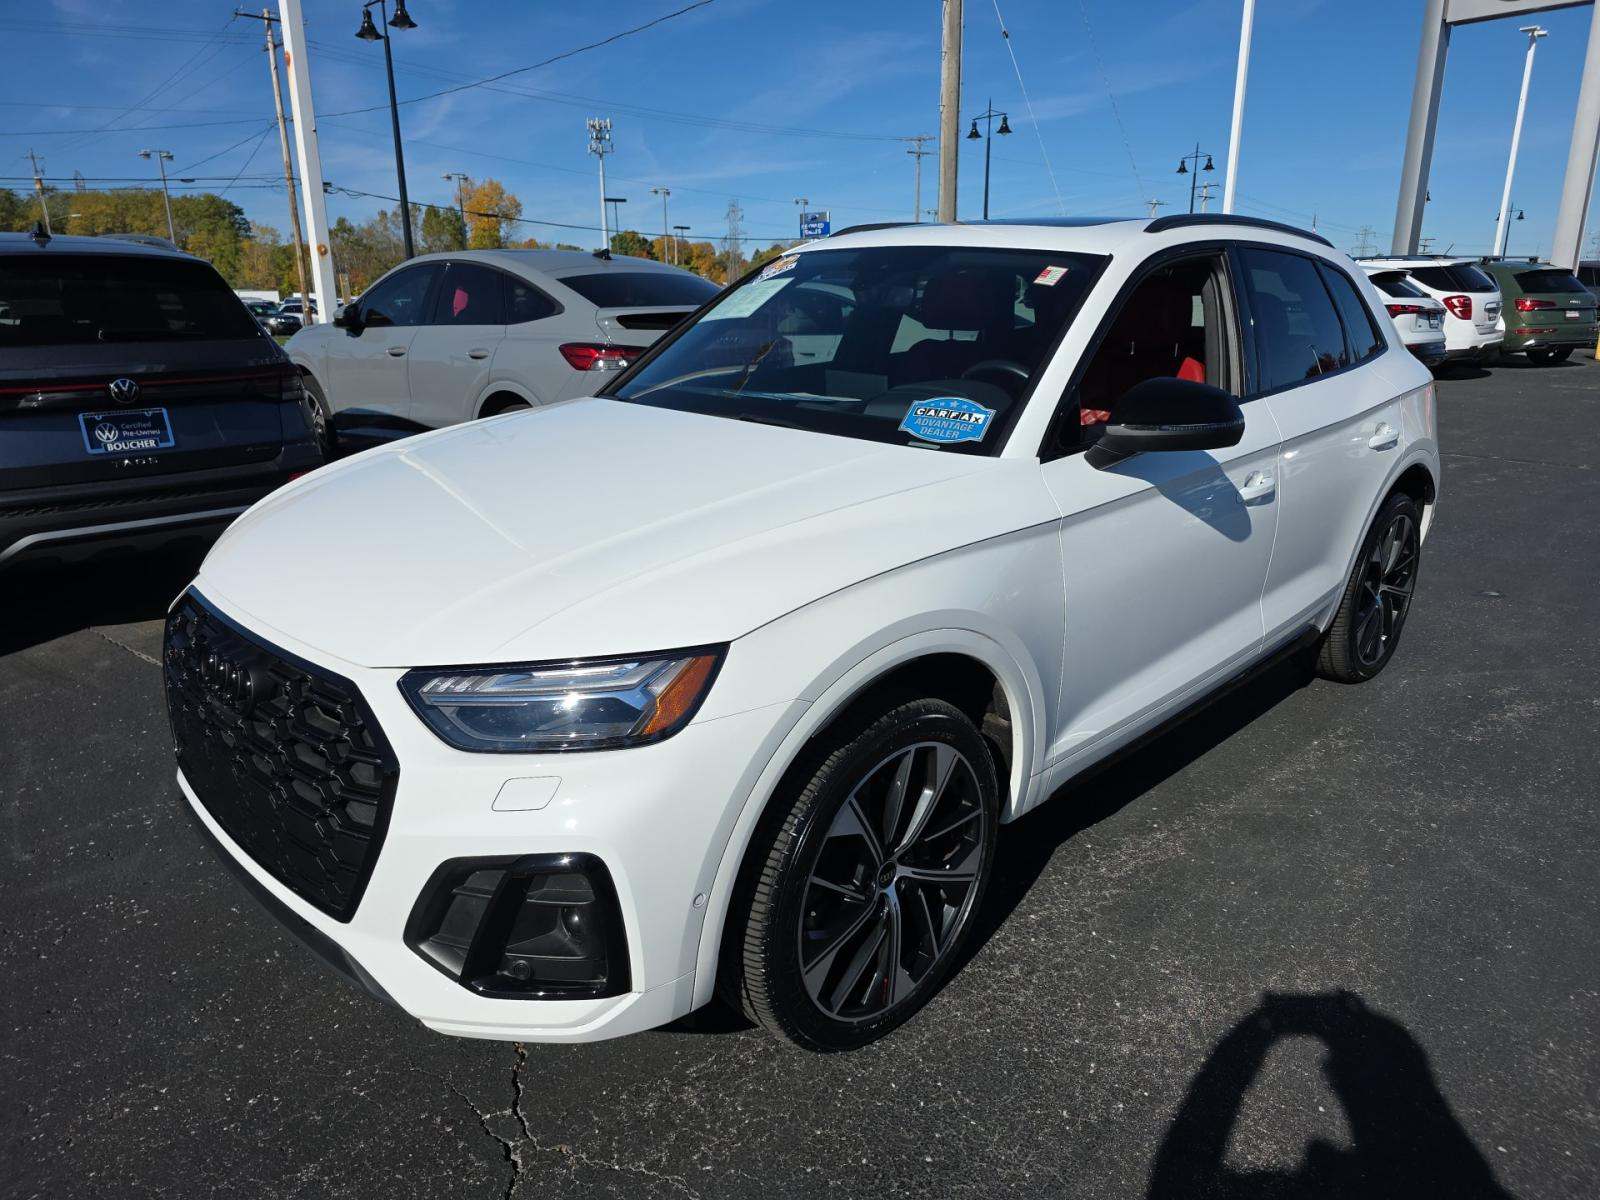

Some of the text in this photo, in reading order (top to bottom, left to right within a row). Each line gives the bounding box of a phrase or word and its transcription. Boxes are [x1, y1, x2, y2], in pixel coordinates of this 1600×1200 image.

[915, 407, 983, 424] CARFAX
[121, 422, 152, 430] Certified
[914, 418, 975, 432] ADVANTAGE
[122, 429, 160, 437] Pre-Owned
[920, 427, 960, 439] DEALER
[107, 439, 157, 451] BOUCHER
